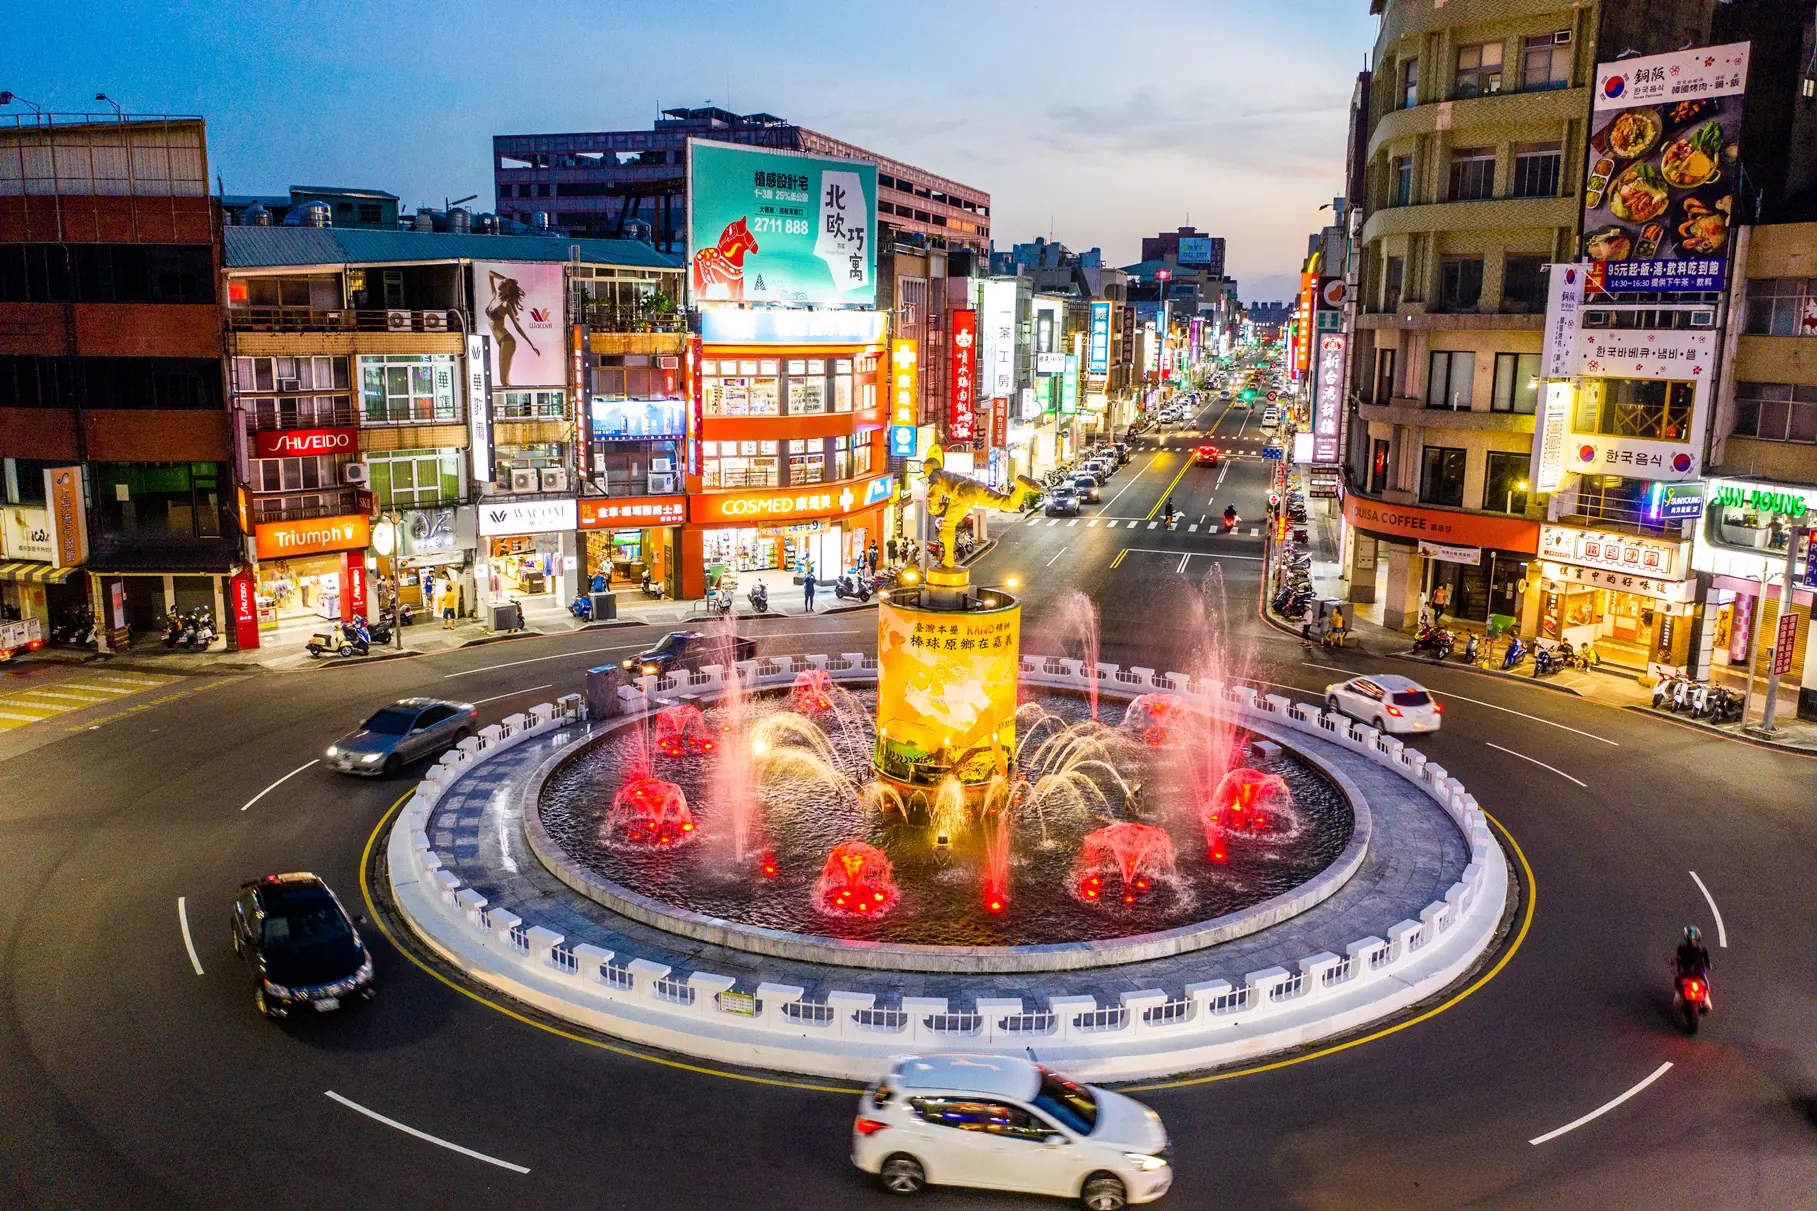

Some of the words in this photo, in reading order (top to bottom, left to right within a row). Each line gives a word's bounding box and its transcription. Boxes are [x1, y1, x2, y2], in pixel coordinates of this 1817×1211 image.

[1633, 66, 1665, 85] 銅阪
[755, 170, 809, 191] 植感設計宅
[754, 217, 782, 233] 2711
[785, 219, 809, 235] 888
[998, 310, 1012, 388] 一茶工房
[269, 433, 349, 451] SHISEIDO
[1606, 449, 1663, 468] 한국음식
[721, 497, 794, 515] COSMED
[1714, 485, 1746, 509] SUN
[1749, 489, 1808, 518] YOUNG
[1352, 506, 1378, 522] OUISA
[1381, 512, 1427, 530] COFFEE
[275, 527, 342, 548] Triumph
[240, 582, 249, 616] SHISEIDO
[910, 633, 1013, 651] 棒球原鄉在嘉義
